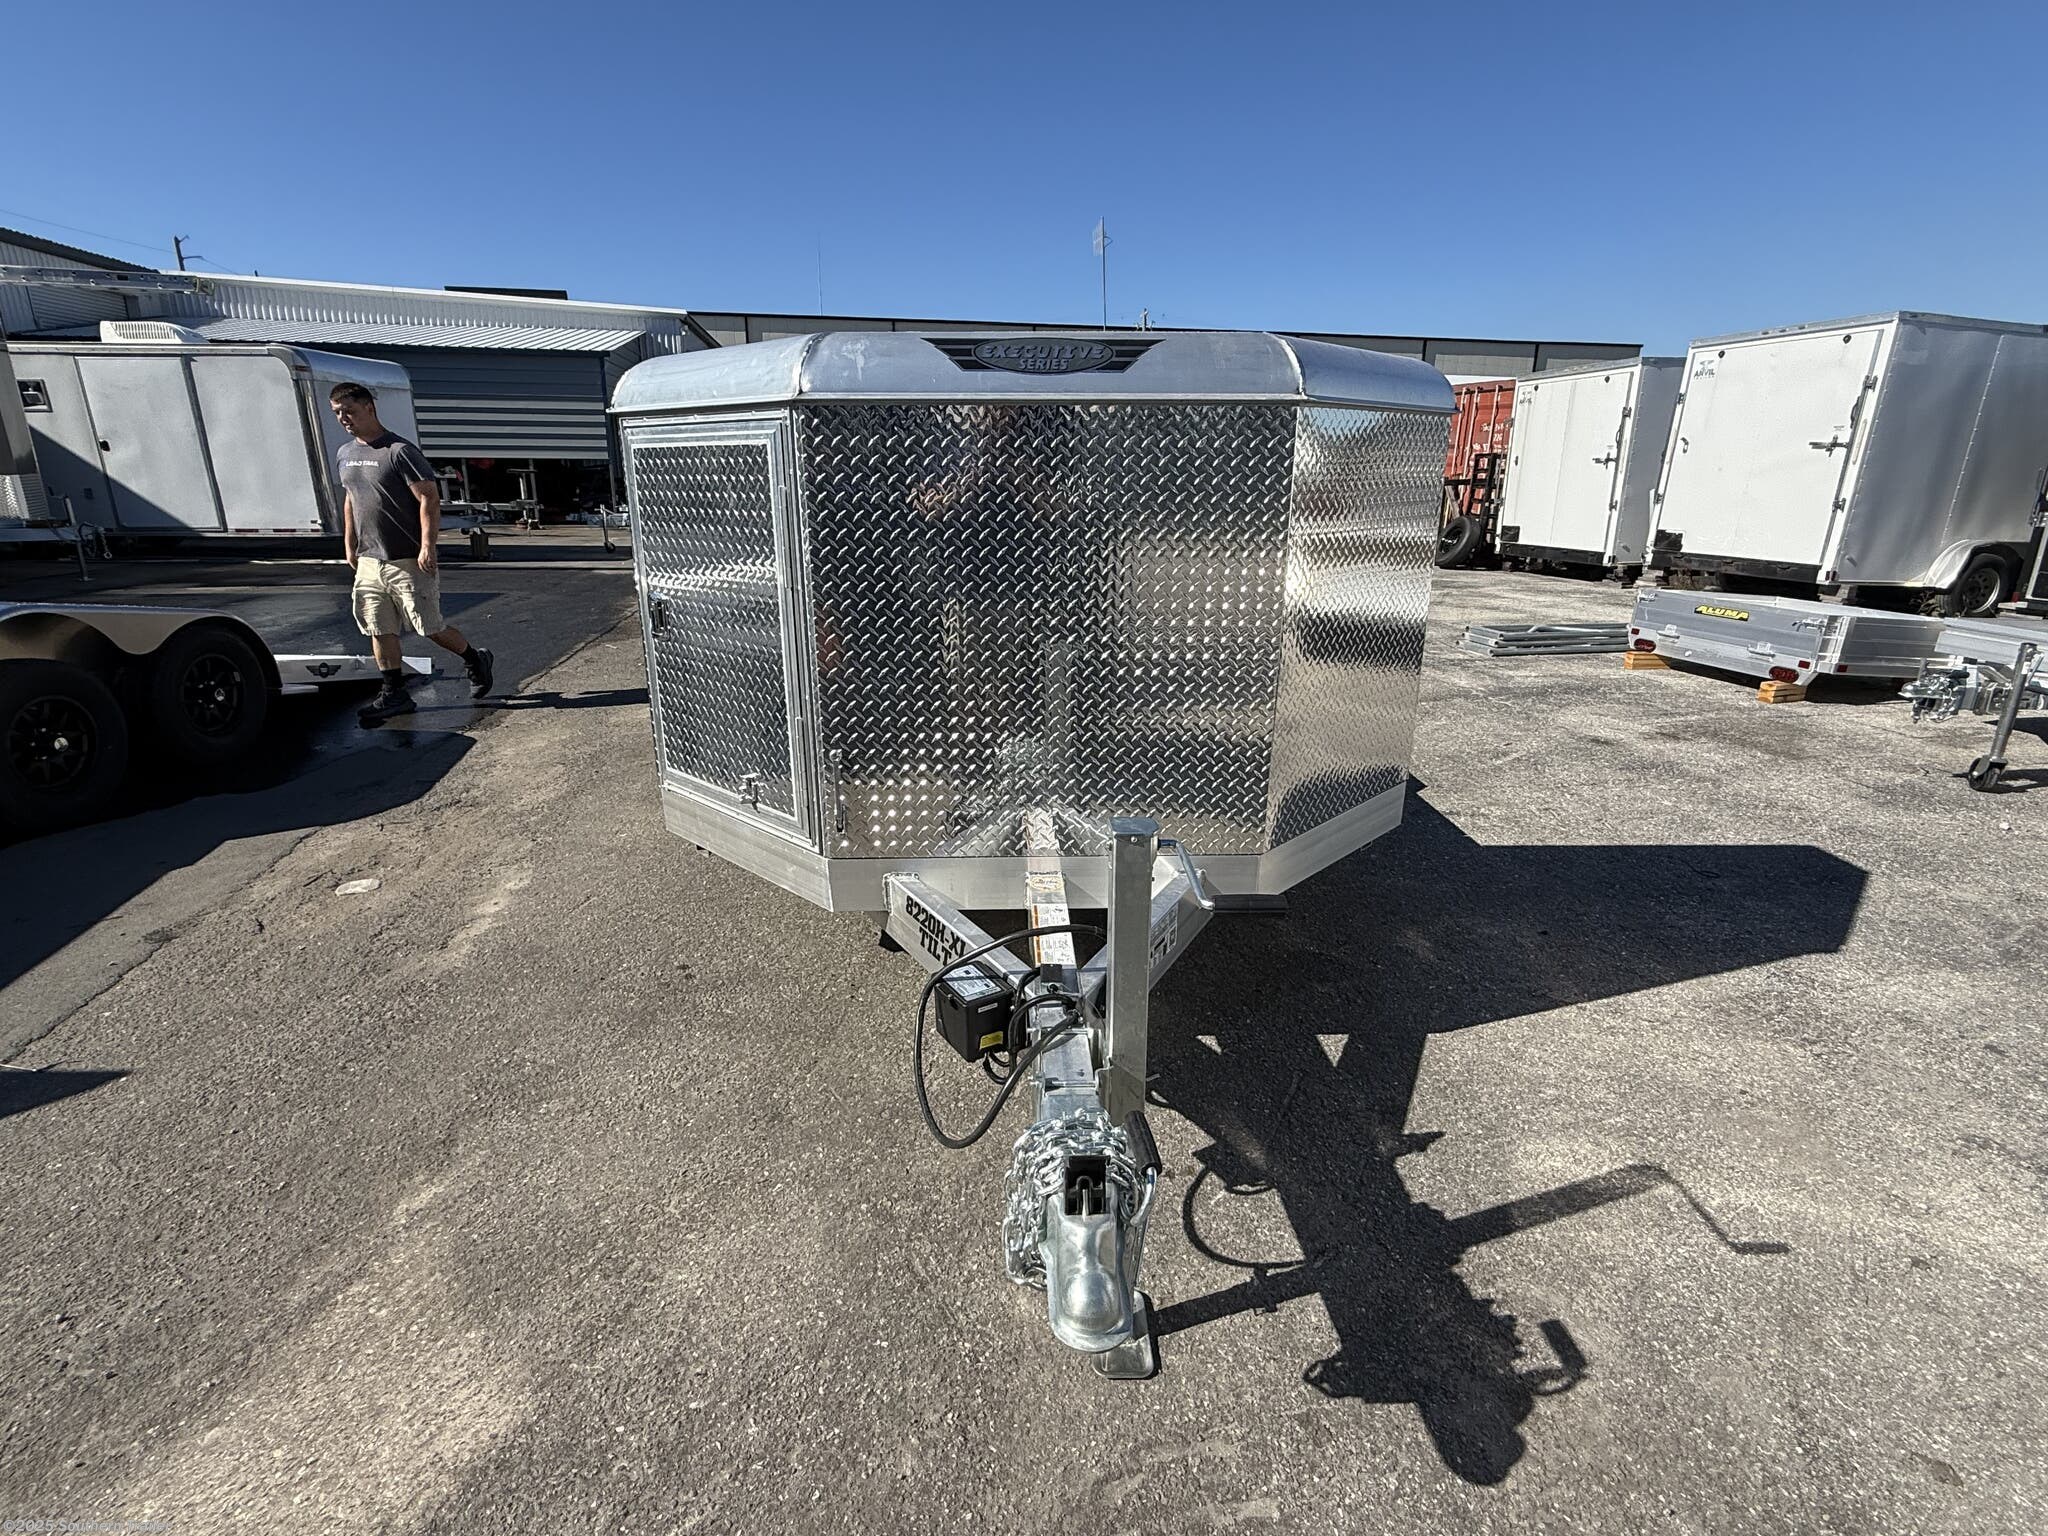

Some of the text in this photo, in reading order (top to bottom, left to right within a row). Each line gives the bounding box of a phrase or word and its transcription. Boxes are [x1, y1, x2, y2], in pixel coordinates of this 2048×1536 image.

[981, 344, 1107, 360] EXECUTIVE
[1018, 358, 1070, 371] SERIES
[1695, 604, 1749, 620] ALUMA
[919, 926, 952, 967] TILT
